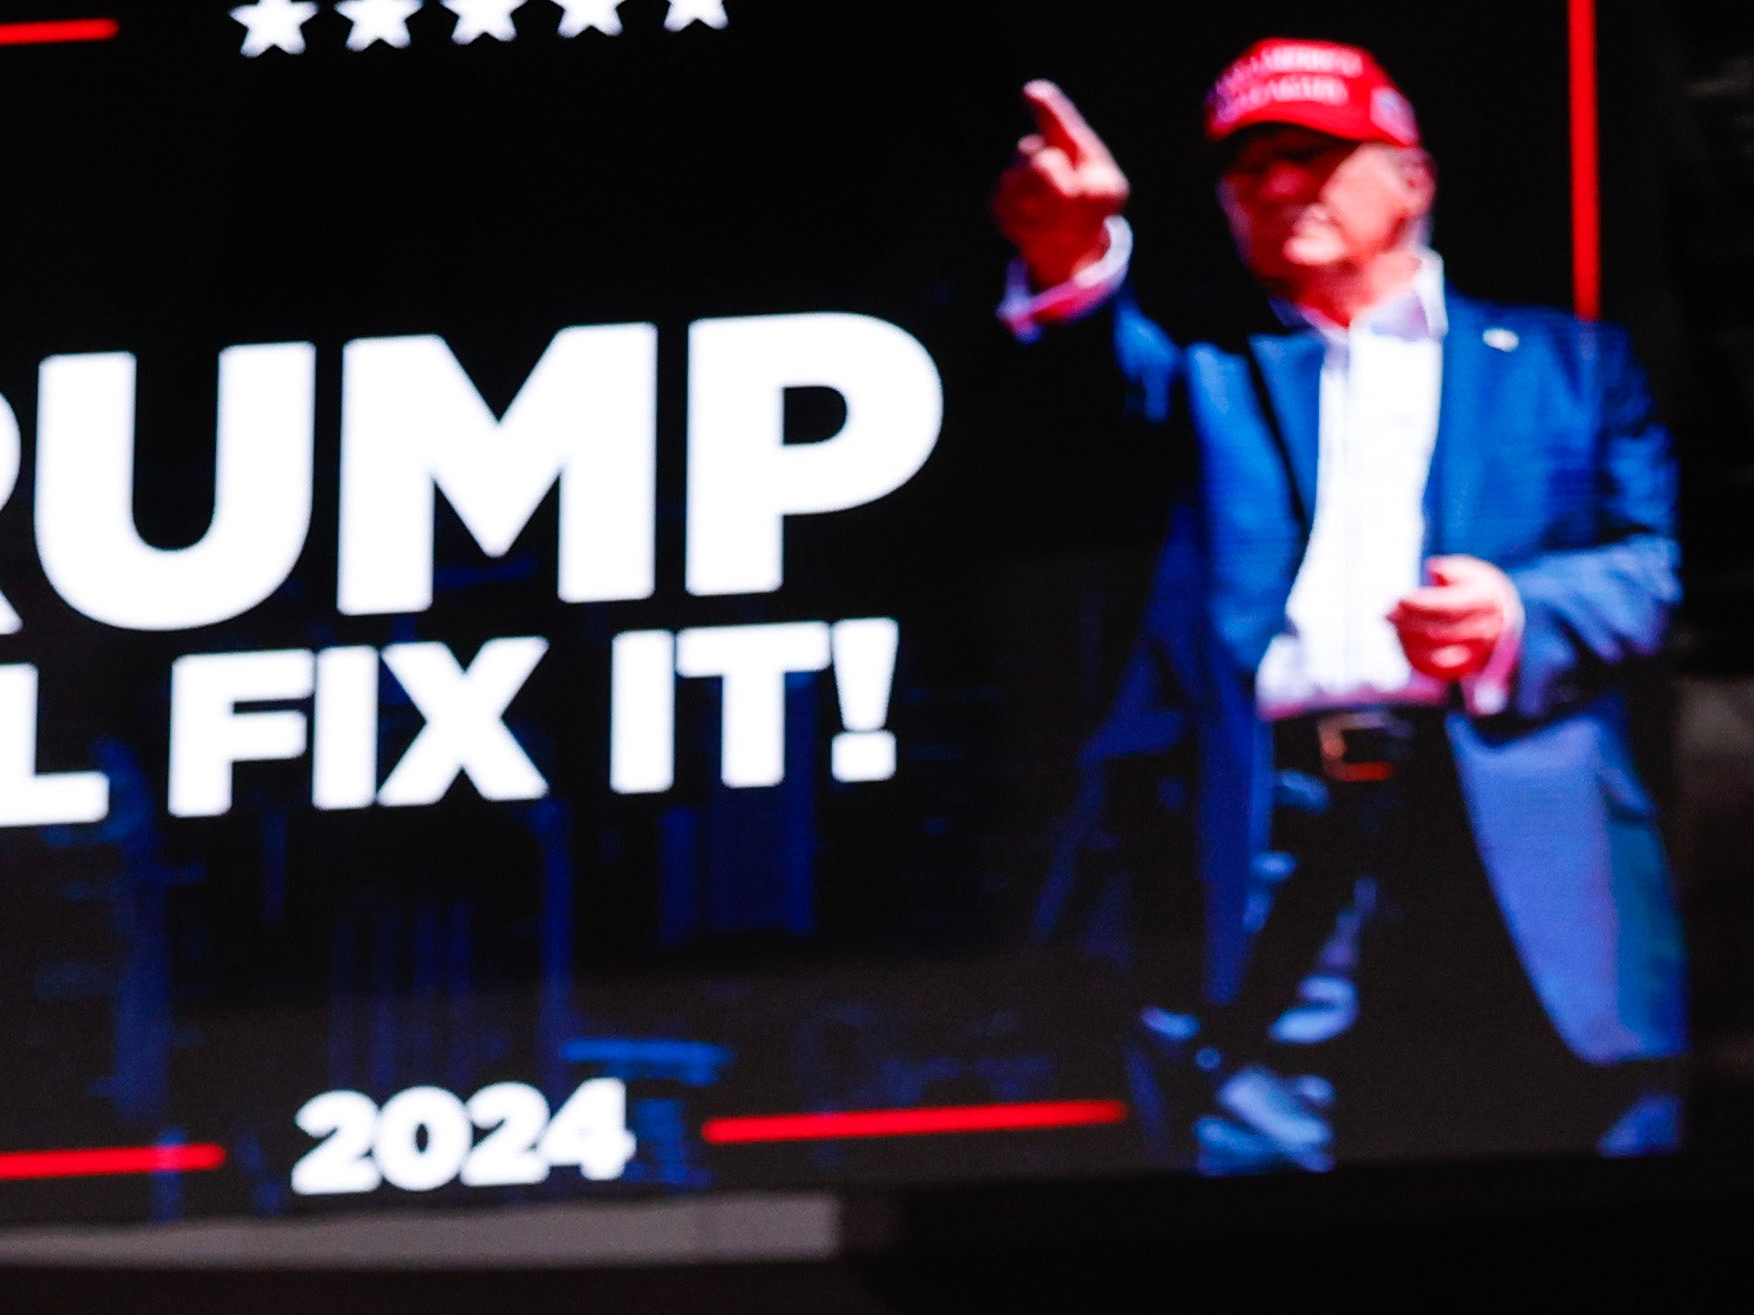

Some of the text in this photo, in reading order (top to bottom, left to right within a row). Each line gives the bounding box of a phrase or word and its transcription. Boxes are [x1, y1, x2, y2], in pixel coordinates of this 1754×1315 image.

[168, 635, 549, 819] FIX
[608, 616, 900, 795] IT!
[290, 1077, 636, 1196] 2024
